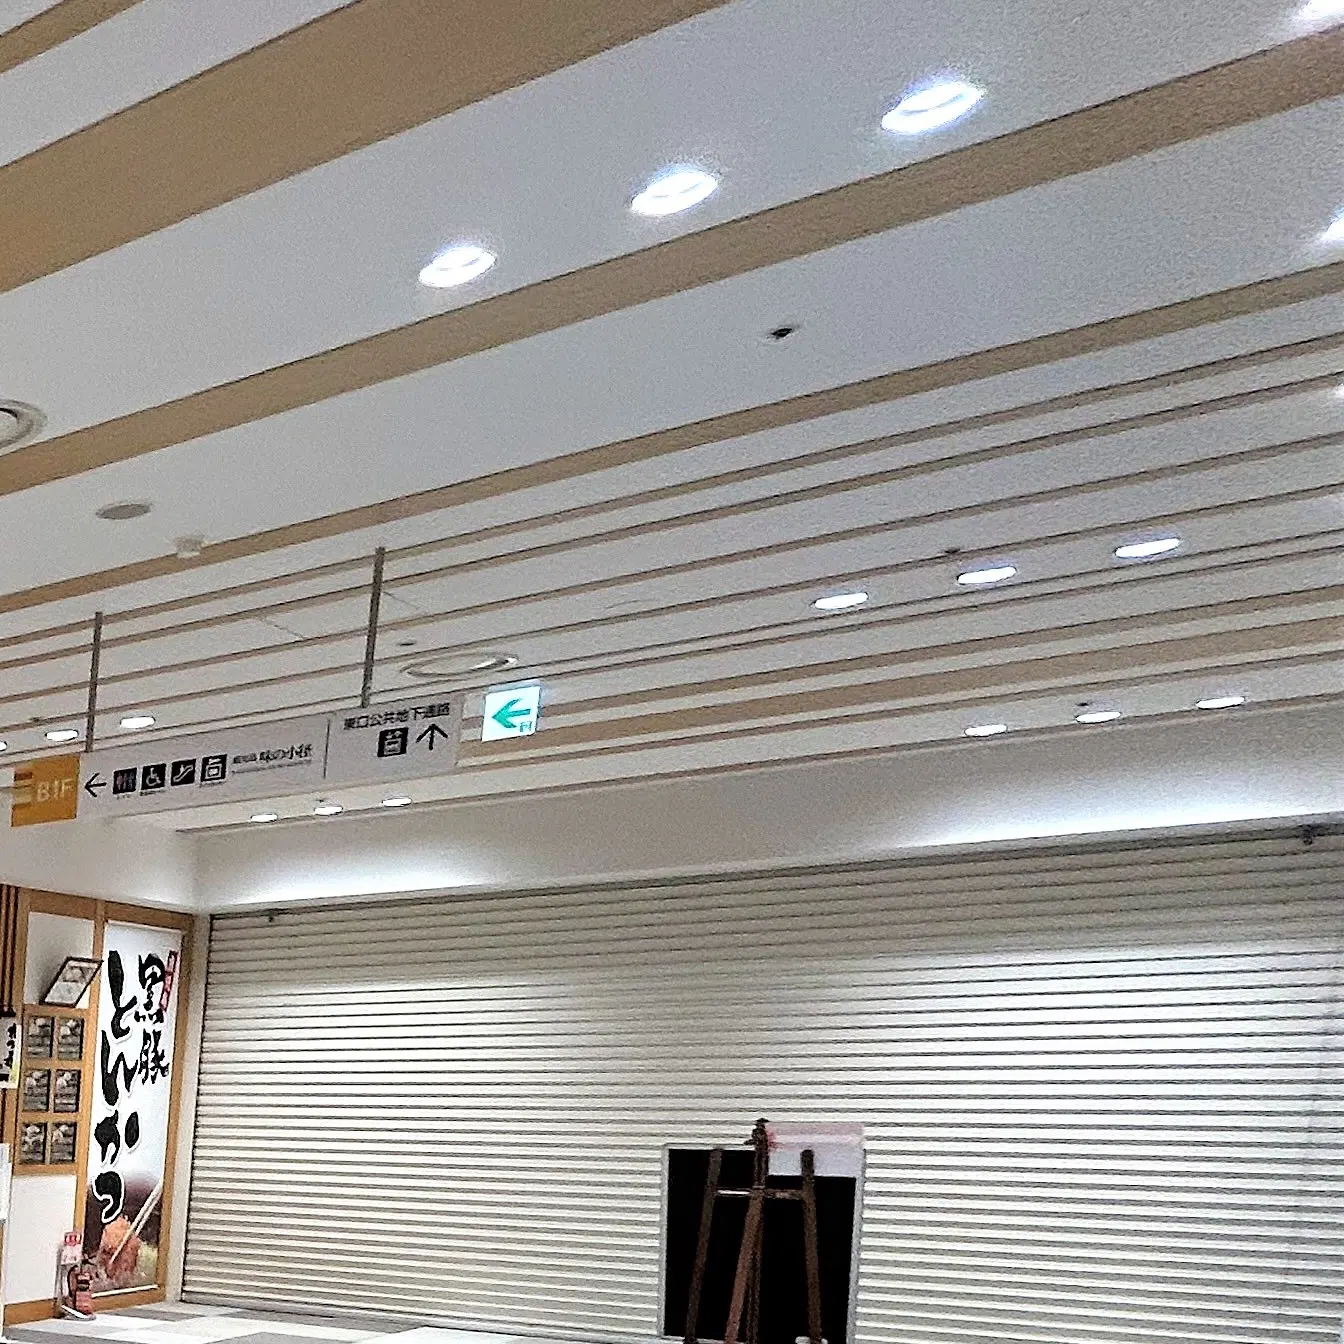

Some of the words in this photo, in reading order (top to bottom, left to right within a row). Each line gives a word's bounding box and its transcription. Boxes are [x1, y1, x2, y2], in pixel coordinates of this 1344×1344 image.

[36, 779, 75, 802] B1F
[93, 949, 140, 1218] とんかつ
